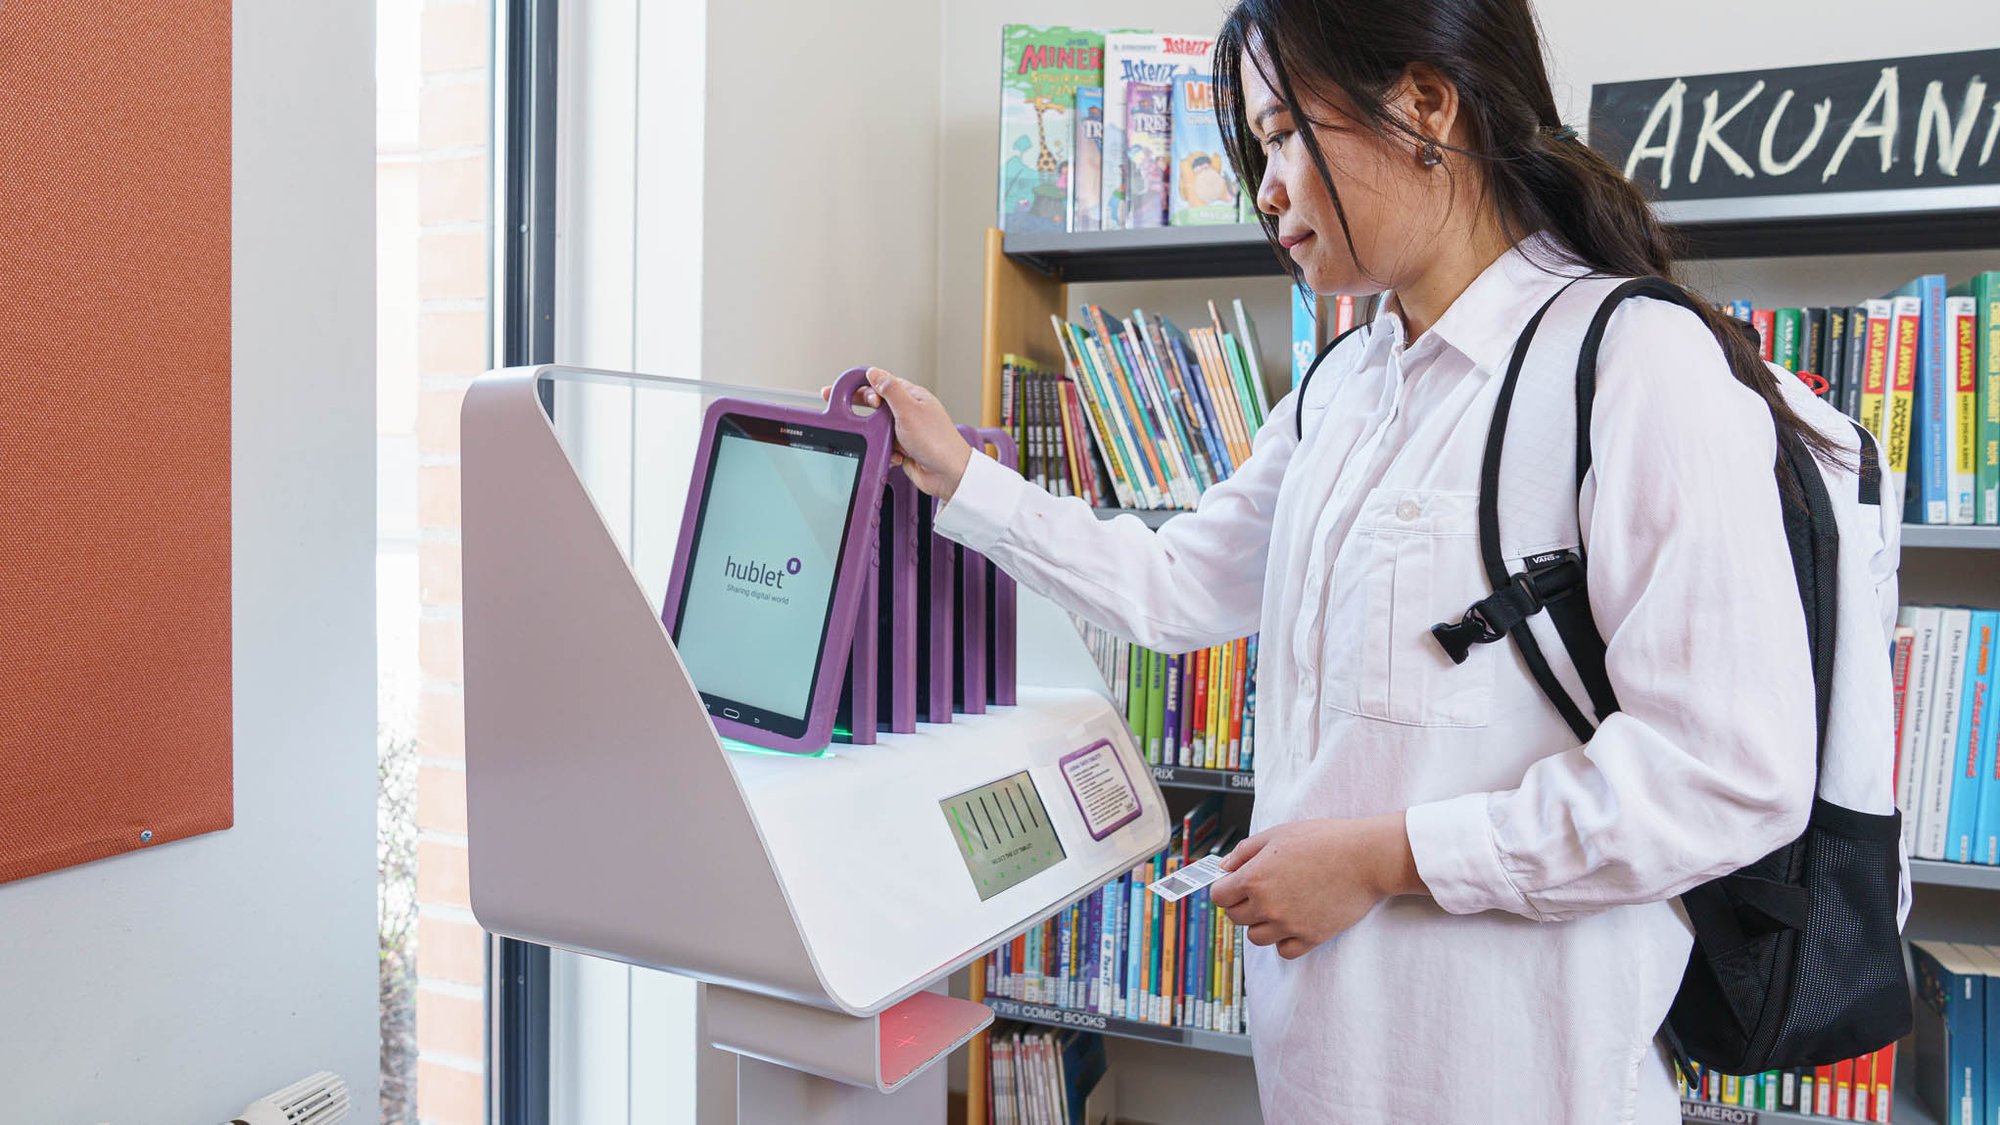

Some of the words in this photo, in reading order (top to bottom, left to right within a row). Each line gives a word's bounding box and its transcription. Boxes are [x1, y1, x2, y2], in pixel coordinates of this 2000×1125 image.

[1163, 37, 1212, 56] Asterix
[1120, 59, 1178, 81] Asterix
[1868, 349, 1884, 389] ANKKA
[1897, 345, 1913, 387] ANKKA
[1960, 345, 1972, 387] ANKKA
[1532, 553, 1556, 564] VANS
[725, 556, 784, 589] hublet
[751, 589, 771, 601] digital
[1022, 1005, 1062, 1022] COMIC
[1062, 1011, 1107, 1029] BOOKS
